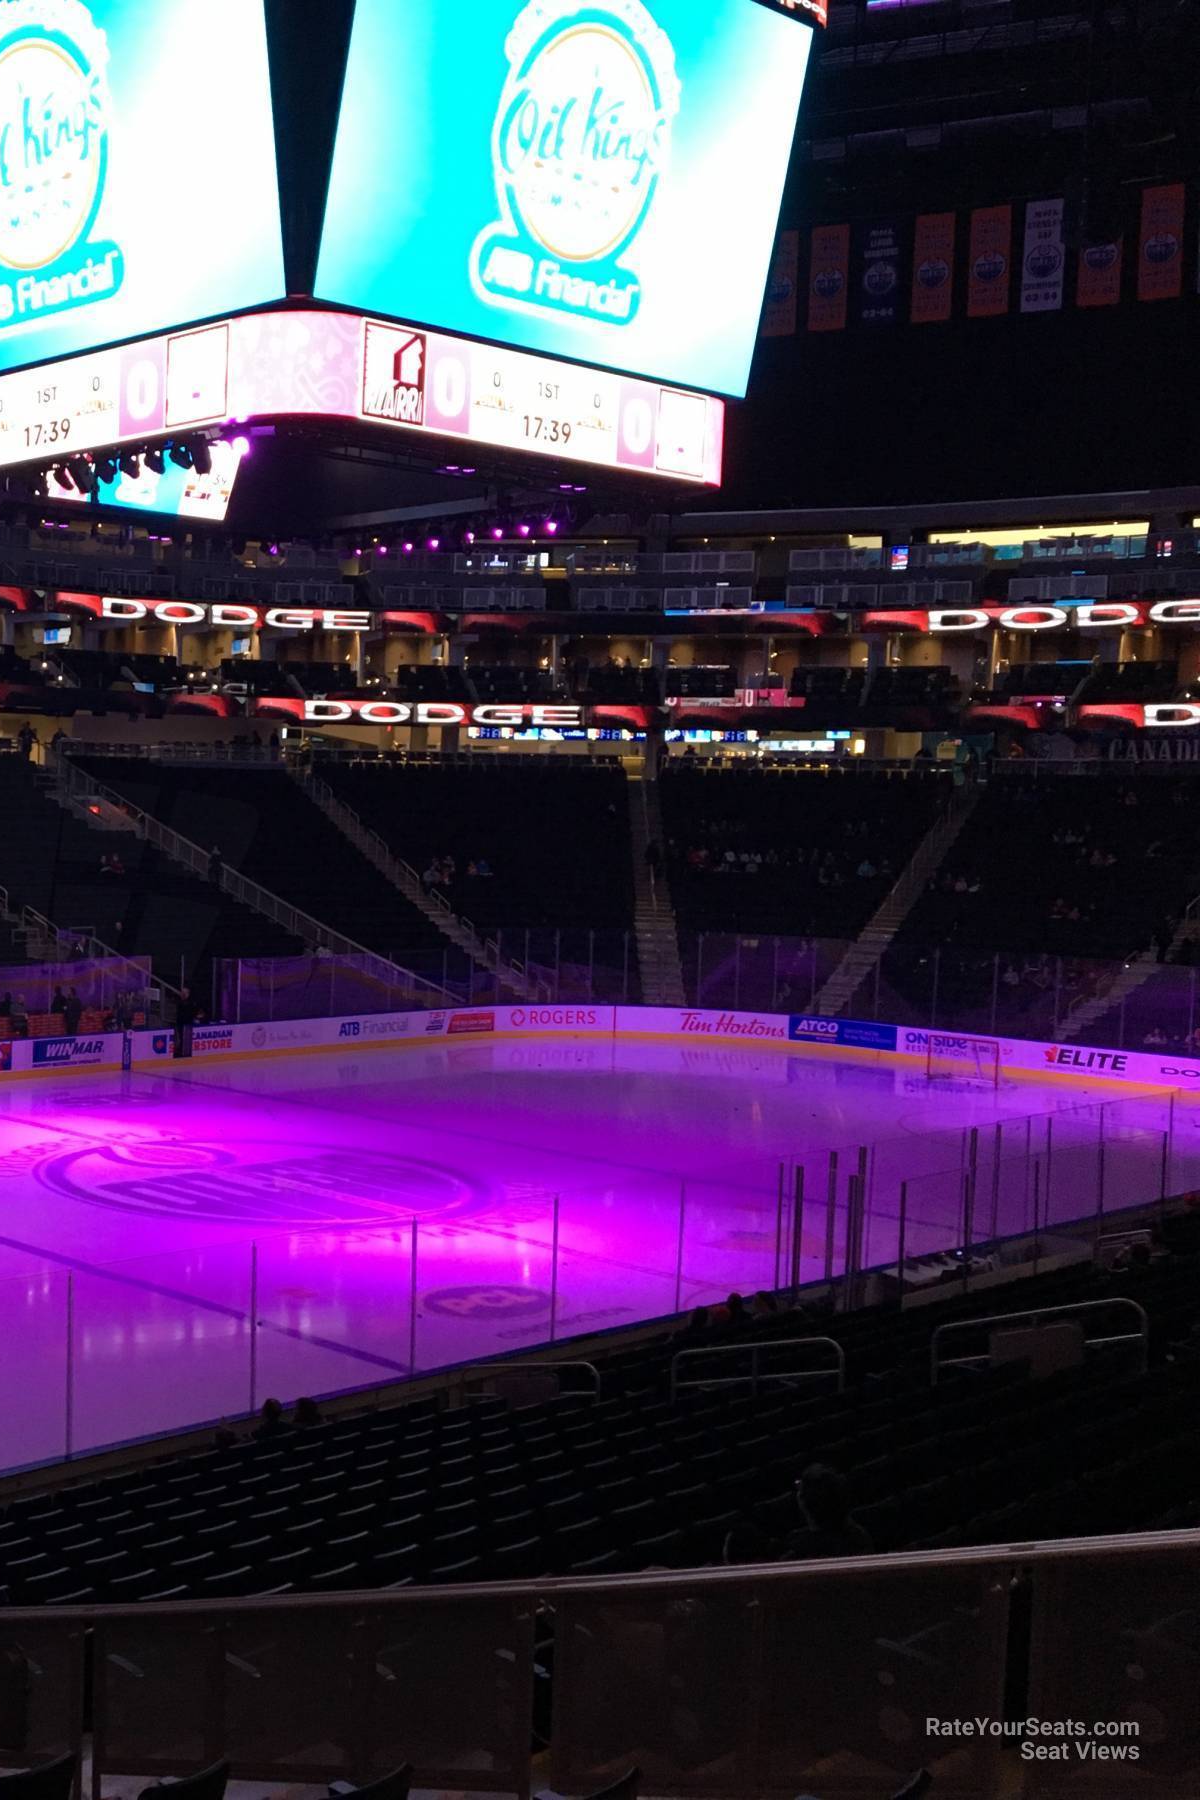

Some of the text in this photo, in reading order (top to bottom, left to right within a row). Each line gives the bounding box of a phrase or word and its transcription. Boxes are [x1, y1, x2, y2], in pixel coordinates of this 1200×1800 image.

[37, 386, 58, 405] 1ST
[538, 382, 560, 401] 1ST
[24, 418, 71, 447] 17:39
[523, 415, 572, 444] 17:39
[102, 597, 371, 630] DODGE
[304, 700, 581, 725] DODGE
[339, 1021, 360, 1037] ATB
[363, 1018, 408, 1035] Financial
[530, 1010, 596, 1025] ROGERS
[680, 1012, 785, 1038] Tim Hortons
[797, 1019, 839, 1033] ATCO
[45, 1039, 105, 1058] WINMAR
[1057, 1049, 1128, 1071] ELITE
